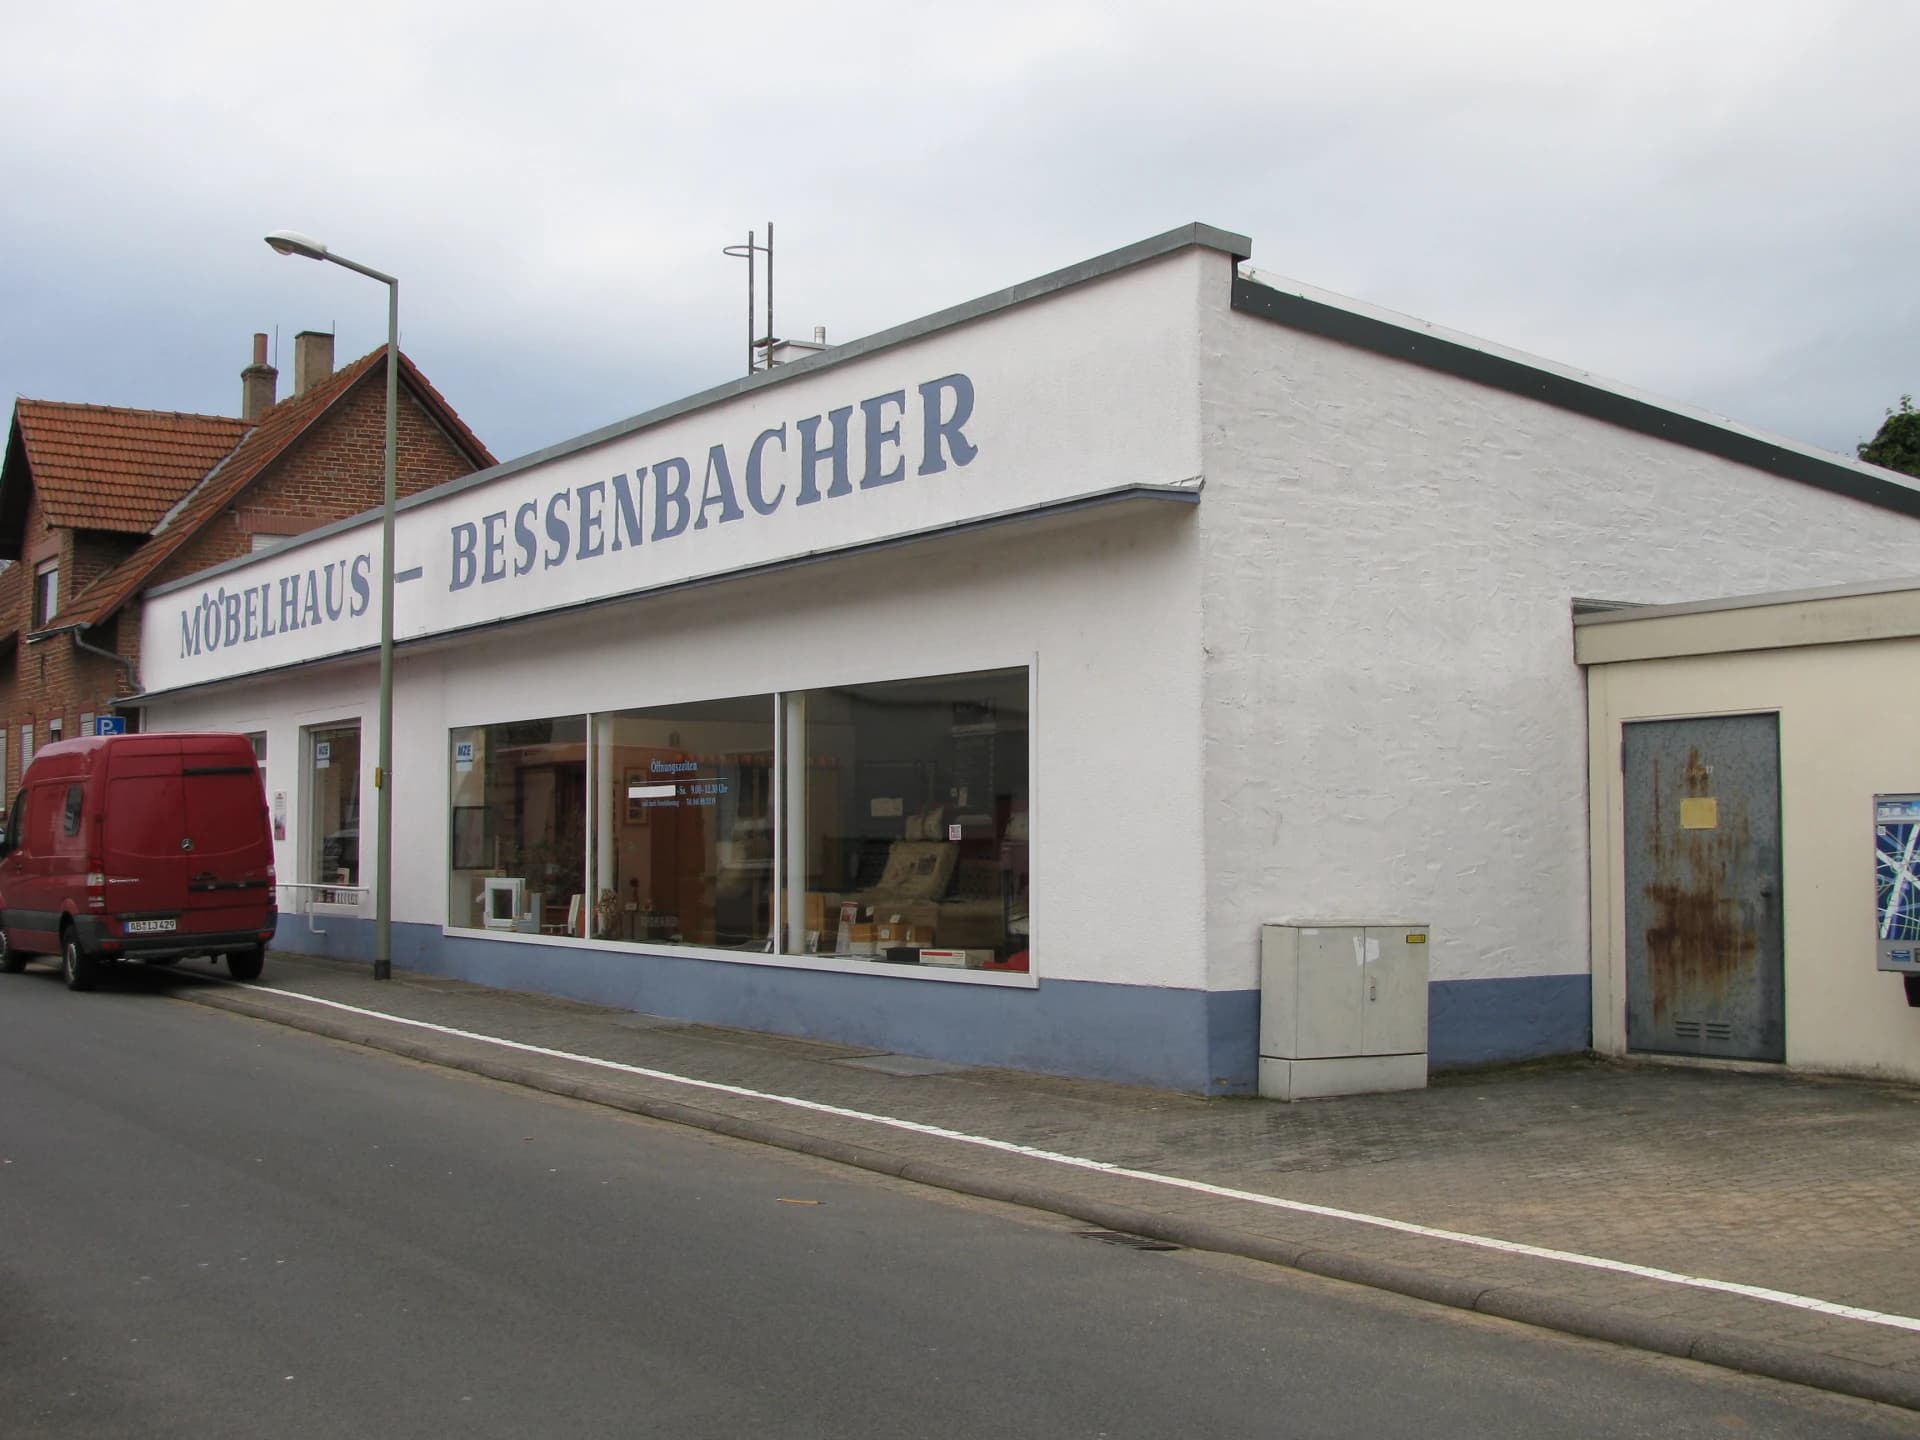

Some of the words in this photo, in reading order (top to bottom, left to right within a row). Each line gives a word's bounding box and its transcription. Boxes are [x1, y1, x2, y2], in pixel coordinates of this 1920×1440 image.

[180, 551, 371, 660] MÖBELHAUS
[448, 372, 980, 593] BESSENBACHER
[101, 719, 113, 735] P
